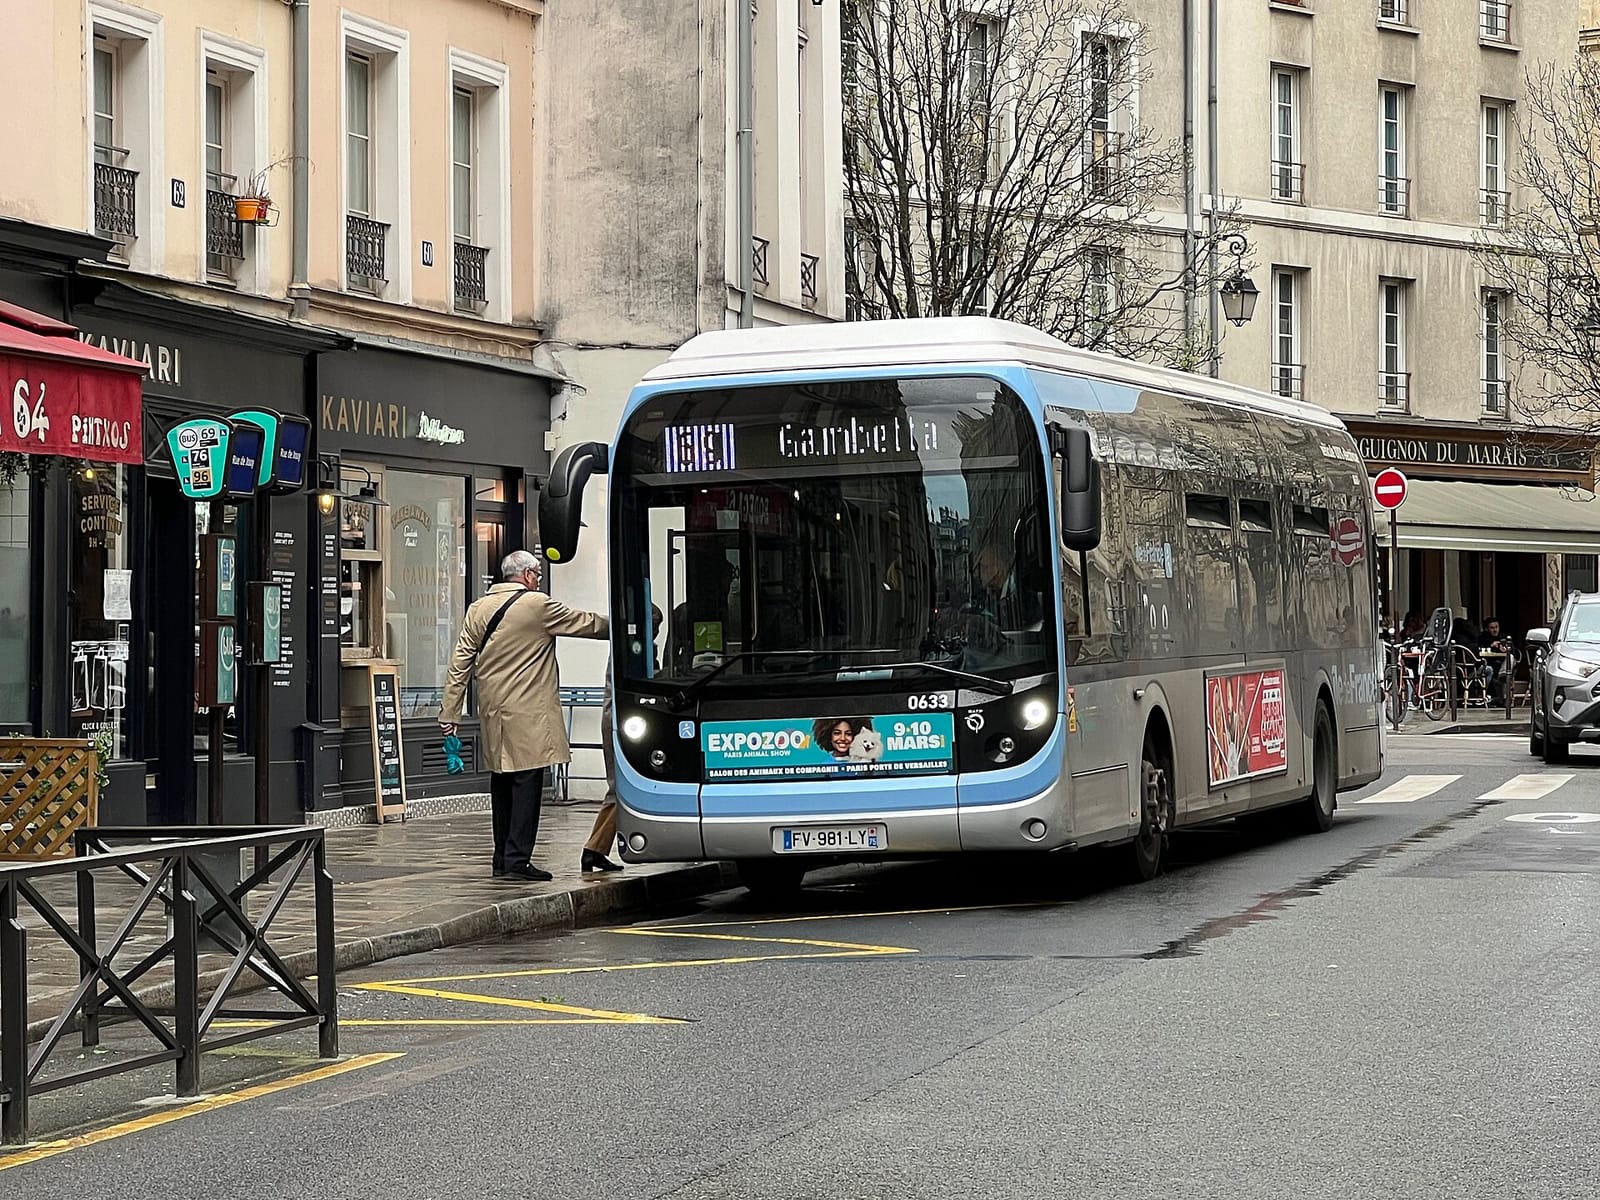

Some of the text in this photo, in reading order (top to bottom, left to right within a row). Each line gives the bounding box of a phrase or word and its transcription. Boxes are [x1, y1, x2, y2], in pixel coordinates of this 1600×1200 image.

[173, 181, 184, 206] 62
[13, 378, 50, 443] 64
[322, 394, 407, 439] KAVIARI
[182, 428, 215, 442] BUS 69
[192, 450, 207, 462] 76
[1436, 442, 1458, 463] DU
[1467, 443, 1527, 466] MARAIS
[193, 470, 209, 482] 96
[82, 494, 120, 513] SERVICE
[907, 694, 949, 710] 0633
[708, 730, 805, 752] EXPOZOO
[886, 735, 941, 751] MARS
[743, 750, 769, 758] ANIMAL
[770, 749, 791, 757] SHOW
[709, 769, 733, 777] SALON
[749, 767, 784, 776] ANIMAUX
[795, 765, 839, 774] COMPAGNIE
[846, 764, 868, 772] PARIS
[869, 763, 893, 771] PORTE
[893, 762, 904, 770] DE
[904, 760, 947, 770] VERSAILLES
[868, 837, 877, 846] 75
